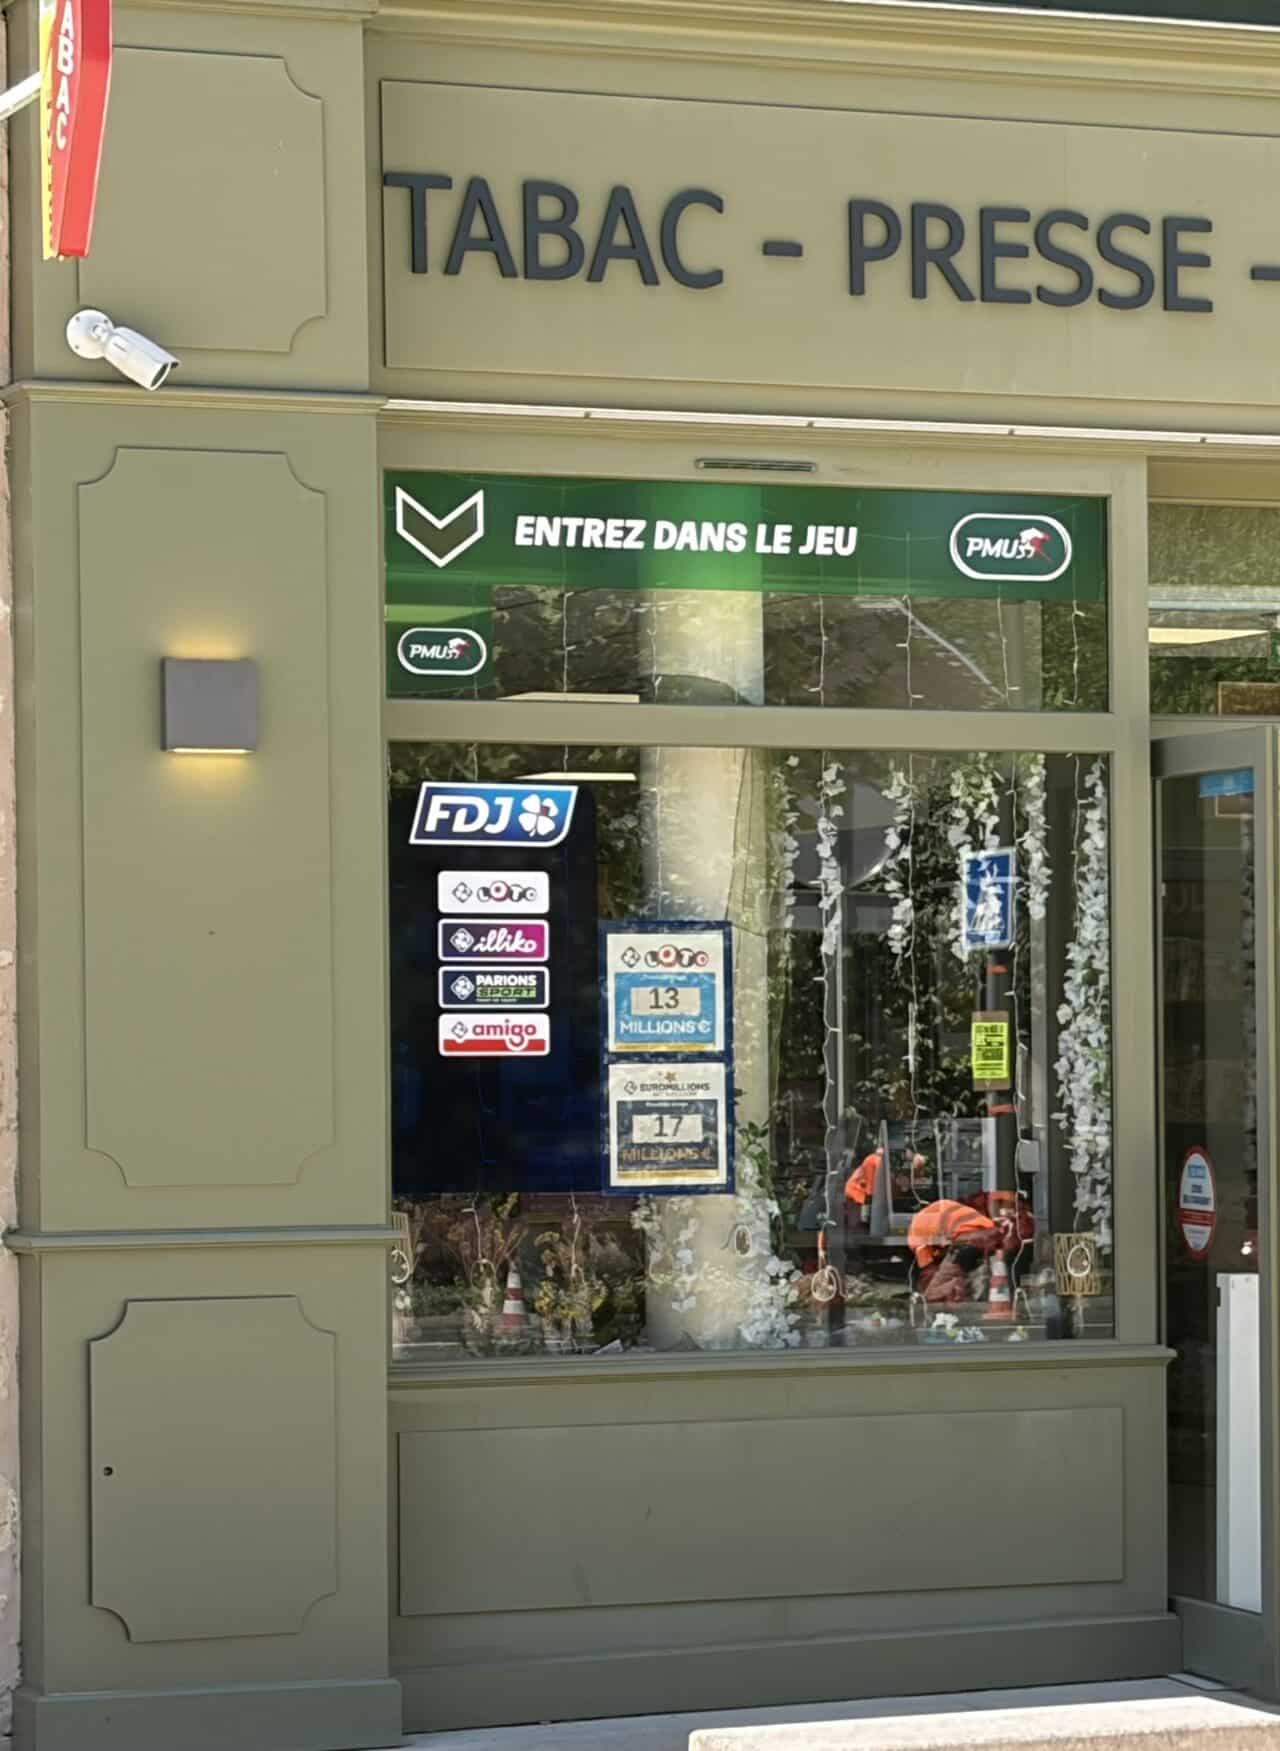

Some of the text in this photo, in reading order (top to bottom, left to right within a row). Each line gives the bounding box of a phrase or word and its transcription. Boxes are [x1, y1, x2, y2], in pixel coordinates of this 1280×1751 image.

[56, 0, 74, 150] ABAC
[383, 171, 725, 290] TABAC
[847, 198, 1213, 314] PRESSE
[515, 515, 857, 556] ENTREZ DANS LE JEU
[966, 536, 1019, 559] PMU
[409, 643, 449, 660] PMU
[424, 794, 514, 834] FDJ
[476, 880, 537, 902] LOTO
[472, 927, 537, 953] illiko
[644, 944, 710, 968] LOTO
[475, 974, 537, 986] PARIONS
[478, 987, 535, 997] SPORT
[649, 986, 680, 1009] 13
[472, 1018, 537, 1047] amigo
[640, 1082, 711, 1092] EUROMILLIONS
[654, 1116, 684, 1137] 17
